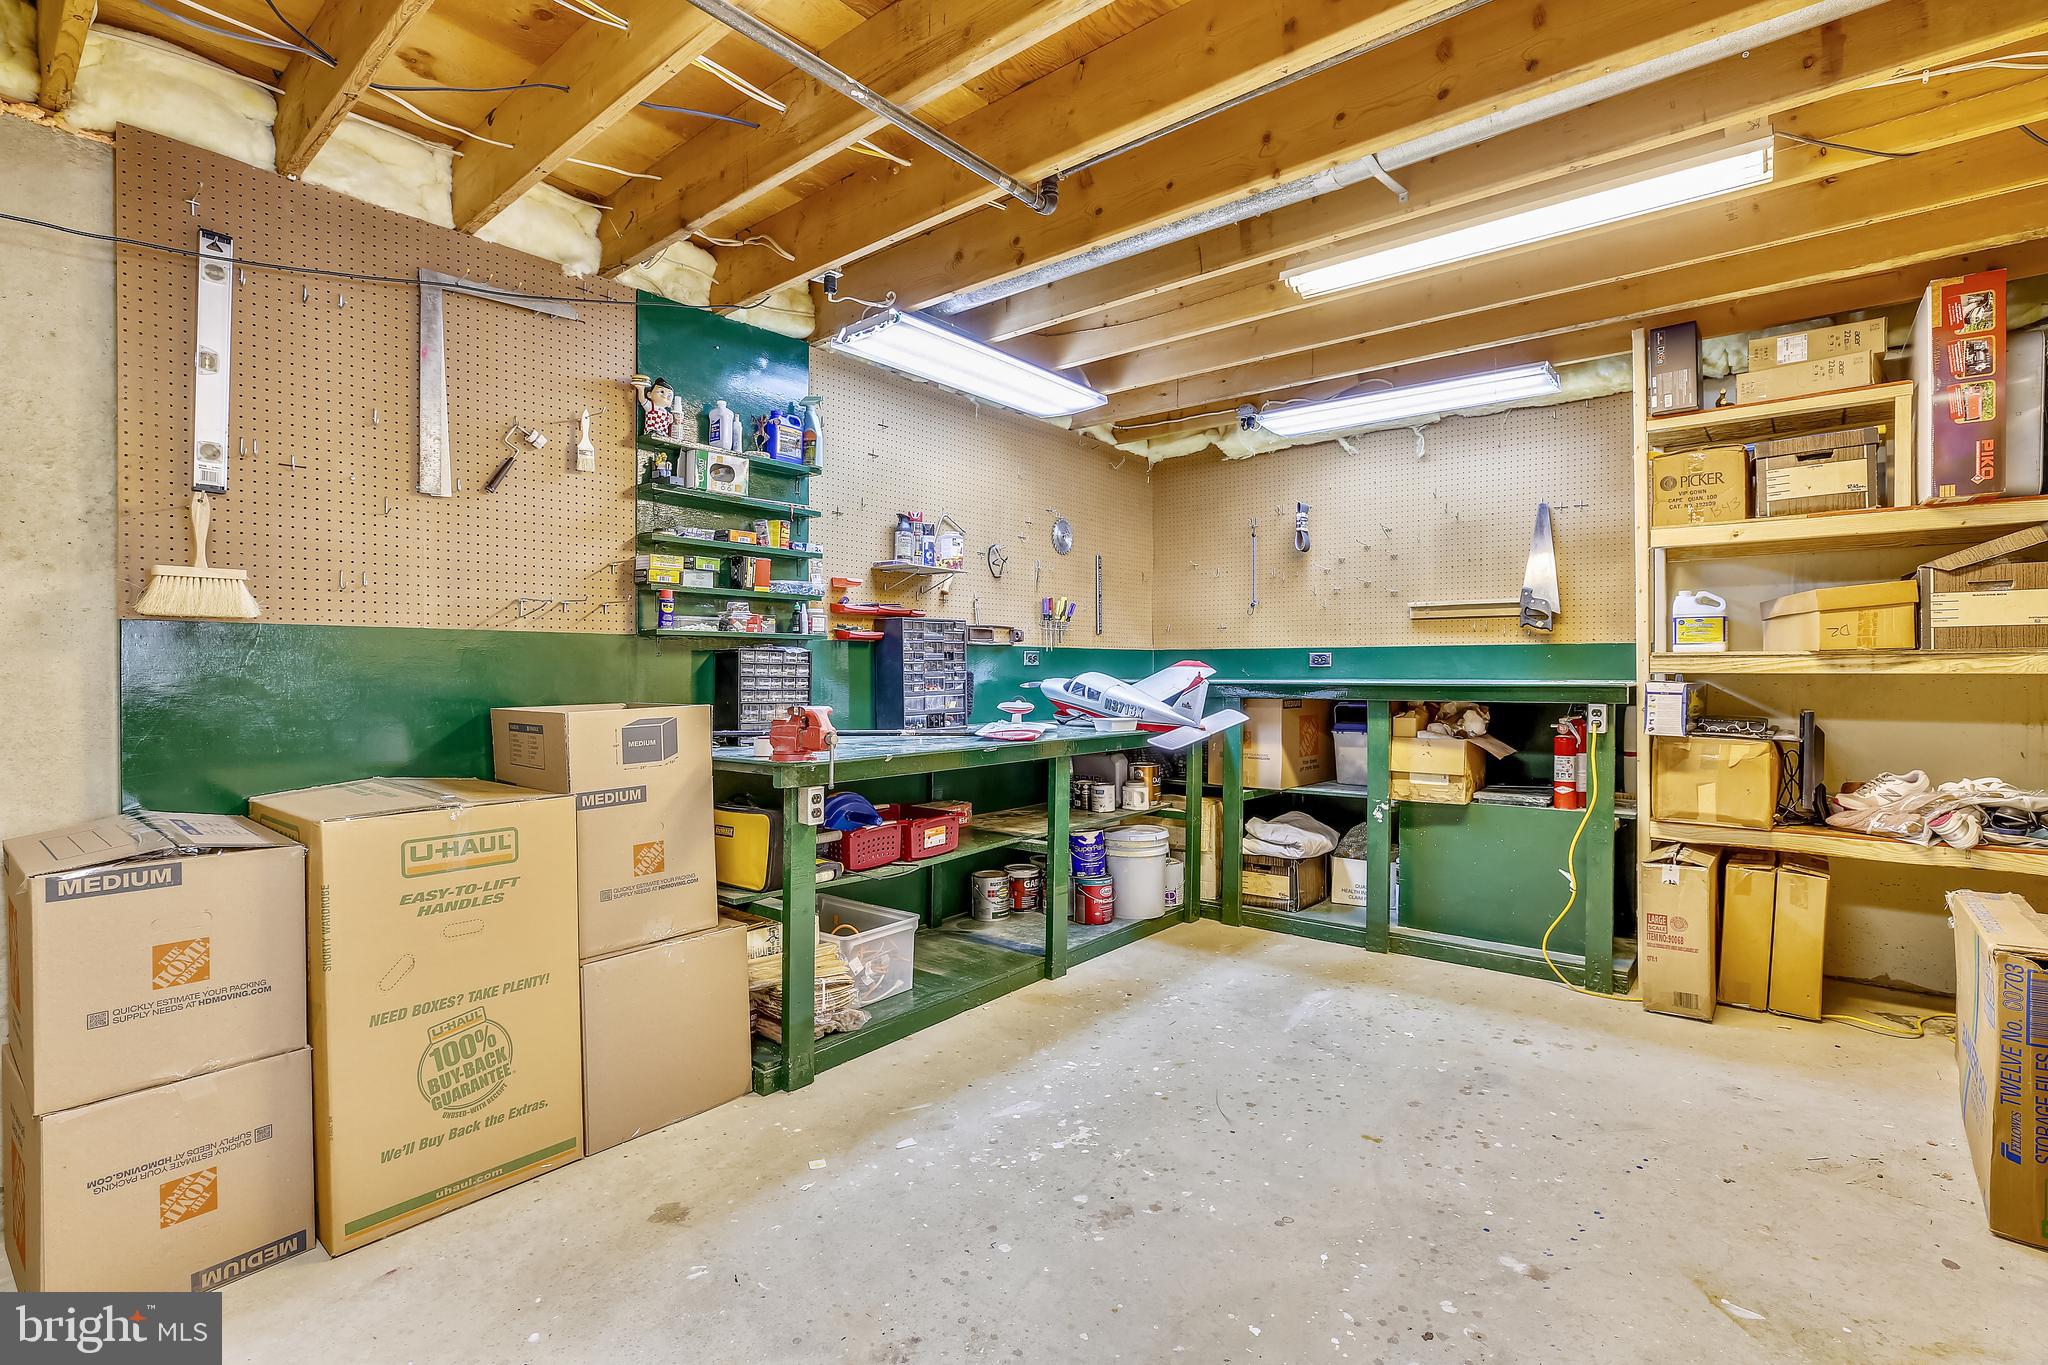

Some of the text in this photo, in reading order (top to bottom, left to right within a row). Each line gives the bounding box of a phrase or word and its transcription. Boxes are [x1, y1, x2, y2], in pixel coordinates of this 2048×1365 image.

[1981, 439, 1995, 480] PIKO
[1680, 472, 1725, 488] PICKER
[1825, 623, 1851, 637] D2
[628, 739, 657, 748] MEDIUM
[581, 788, 642, 808] MEDIUM
[409, 833, 512, 863] U-HAUL
[633, 840, 664, 877] HOME
[57, 867, 173, 897] MEDIUM
[399, 876, 521, 906] EASY-TO-LIFT
[613, 885, 636, 894] QUICKLY
[636, 880, 660, 889] ESTIMATE
[675, 872, 696, 880] PACKING
[613, 890, 634, 900] SUPPLY
[634, 887, 652, 896] NEEDS
[658, 877, 699, 890] HDMOVING.COM
[416, 892, 505, 917] HANDLES
[1648, 914, 1666, 924] LARGE
[320, 884, 332, 972] SHORTY WARDROBE
[152, 938, 209, 988] HOME
[158, 946, 183, 966] THE
[175, 953, 210, 984] DEPOT
[112, 979, 267, 1016] QUICKLY ESTIMATE YOUR PACKING
[112, 985, 272, 1024] SUPPLY NEEDS AT HDMOVING.COM
[368, 972, 551, 1028] NEED BOXES? TAKE PLENTY!
[431, 1010, 484, 1037] U-HAUL
[2000, 963, 2025, 1105] TWELVE No. 00703
[429, 1025, 497, 1072] 100%
[426, 1046, 508, 1096] BUY-BACK
[430, 1063, 513, 1112] GUARANTEE
[486, 1083, 509, 1106] RECEIPT
[380, 1098, 549, 1164] We'll Buy Back the Extras.
[2008, 1110, 2022, 1157] FELLOWES
[86, 1131, 252, 1190] SUPPLY NEEDS AT HDMOVING.COM
[93, 1138, 252, 1196] QUICKLY ESTIMATE YOUR PACKING
[160, 1170, 217, 1225] HOME
[435, 1167, 503, 1200] uhaul.com
[201, 1237, 298, 1289] MEDIUM
